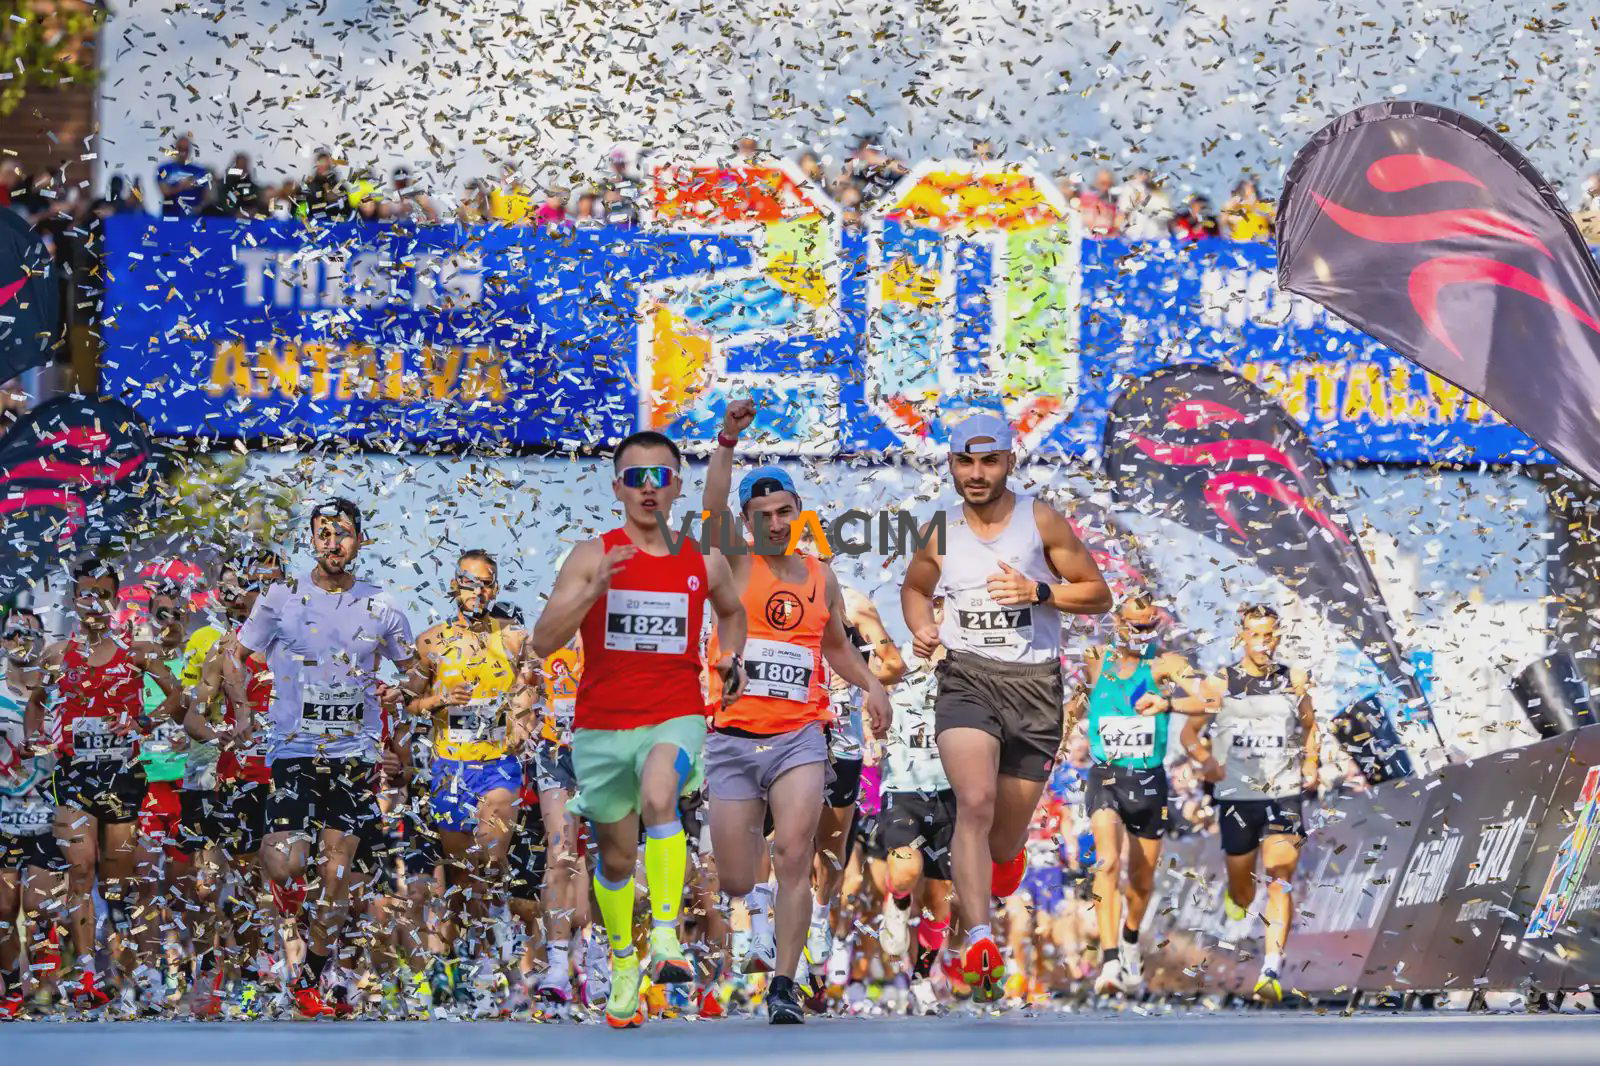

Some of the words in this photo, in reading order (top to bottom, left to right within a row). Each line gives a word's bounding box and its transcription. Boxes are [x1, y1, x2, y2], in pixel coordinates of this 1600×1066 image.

[638, 158, 1081, 456] 20
[206, 342, 505, 400] ANTALYA
[620, 616, 676, 635] 1824
[967, 611, 1021, 629] 2147
[755, 662, 805, 685] 1802
